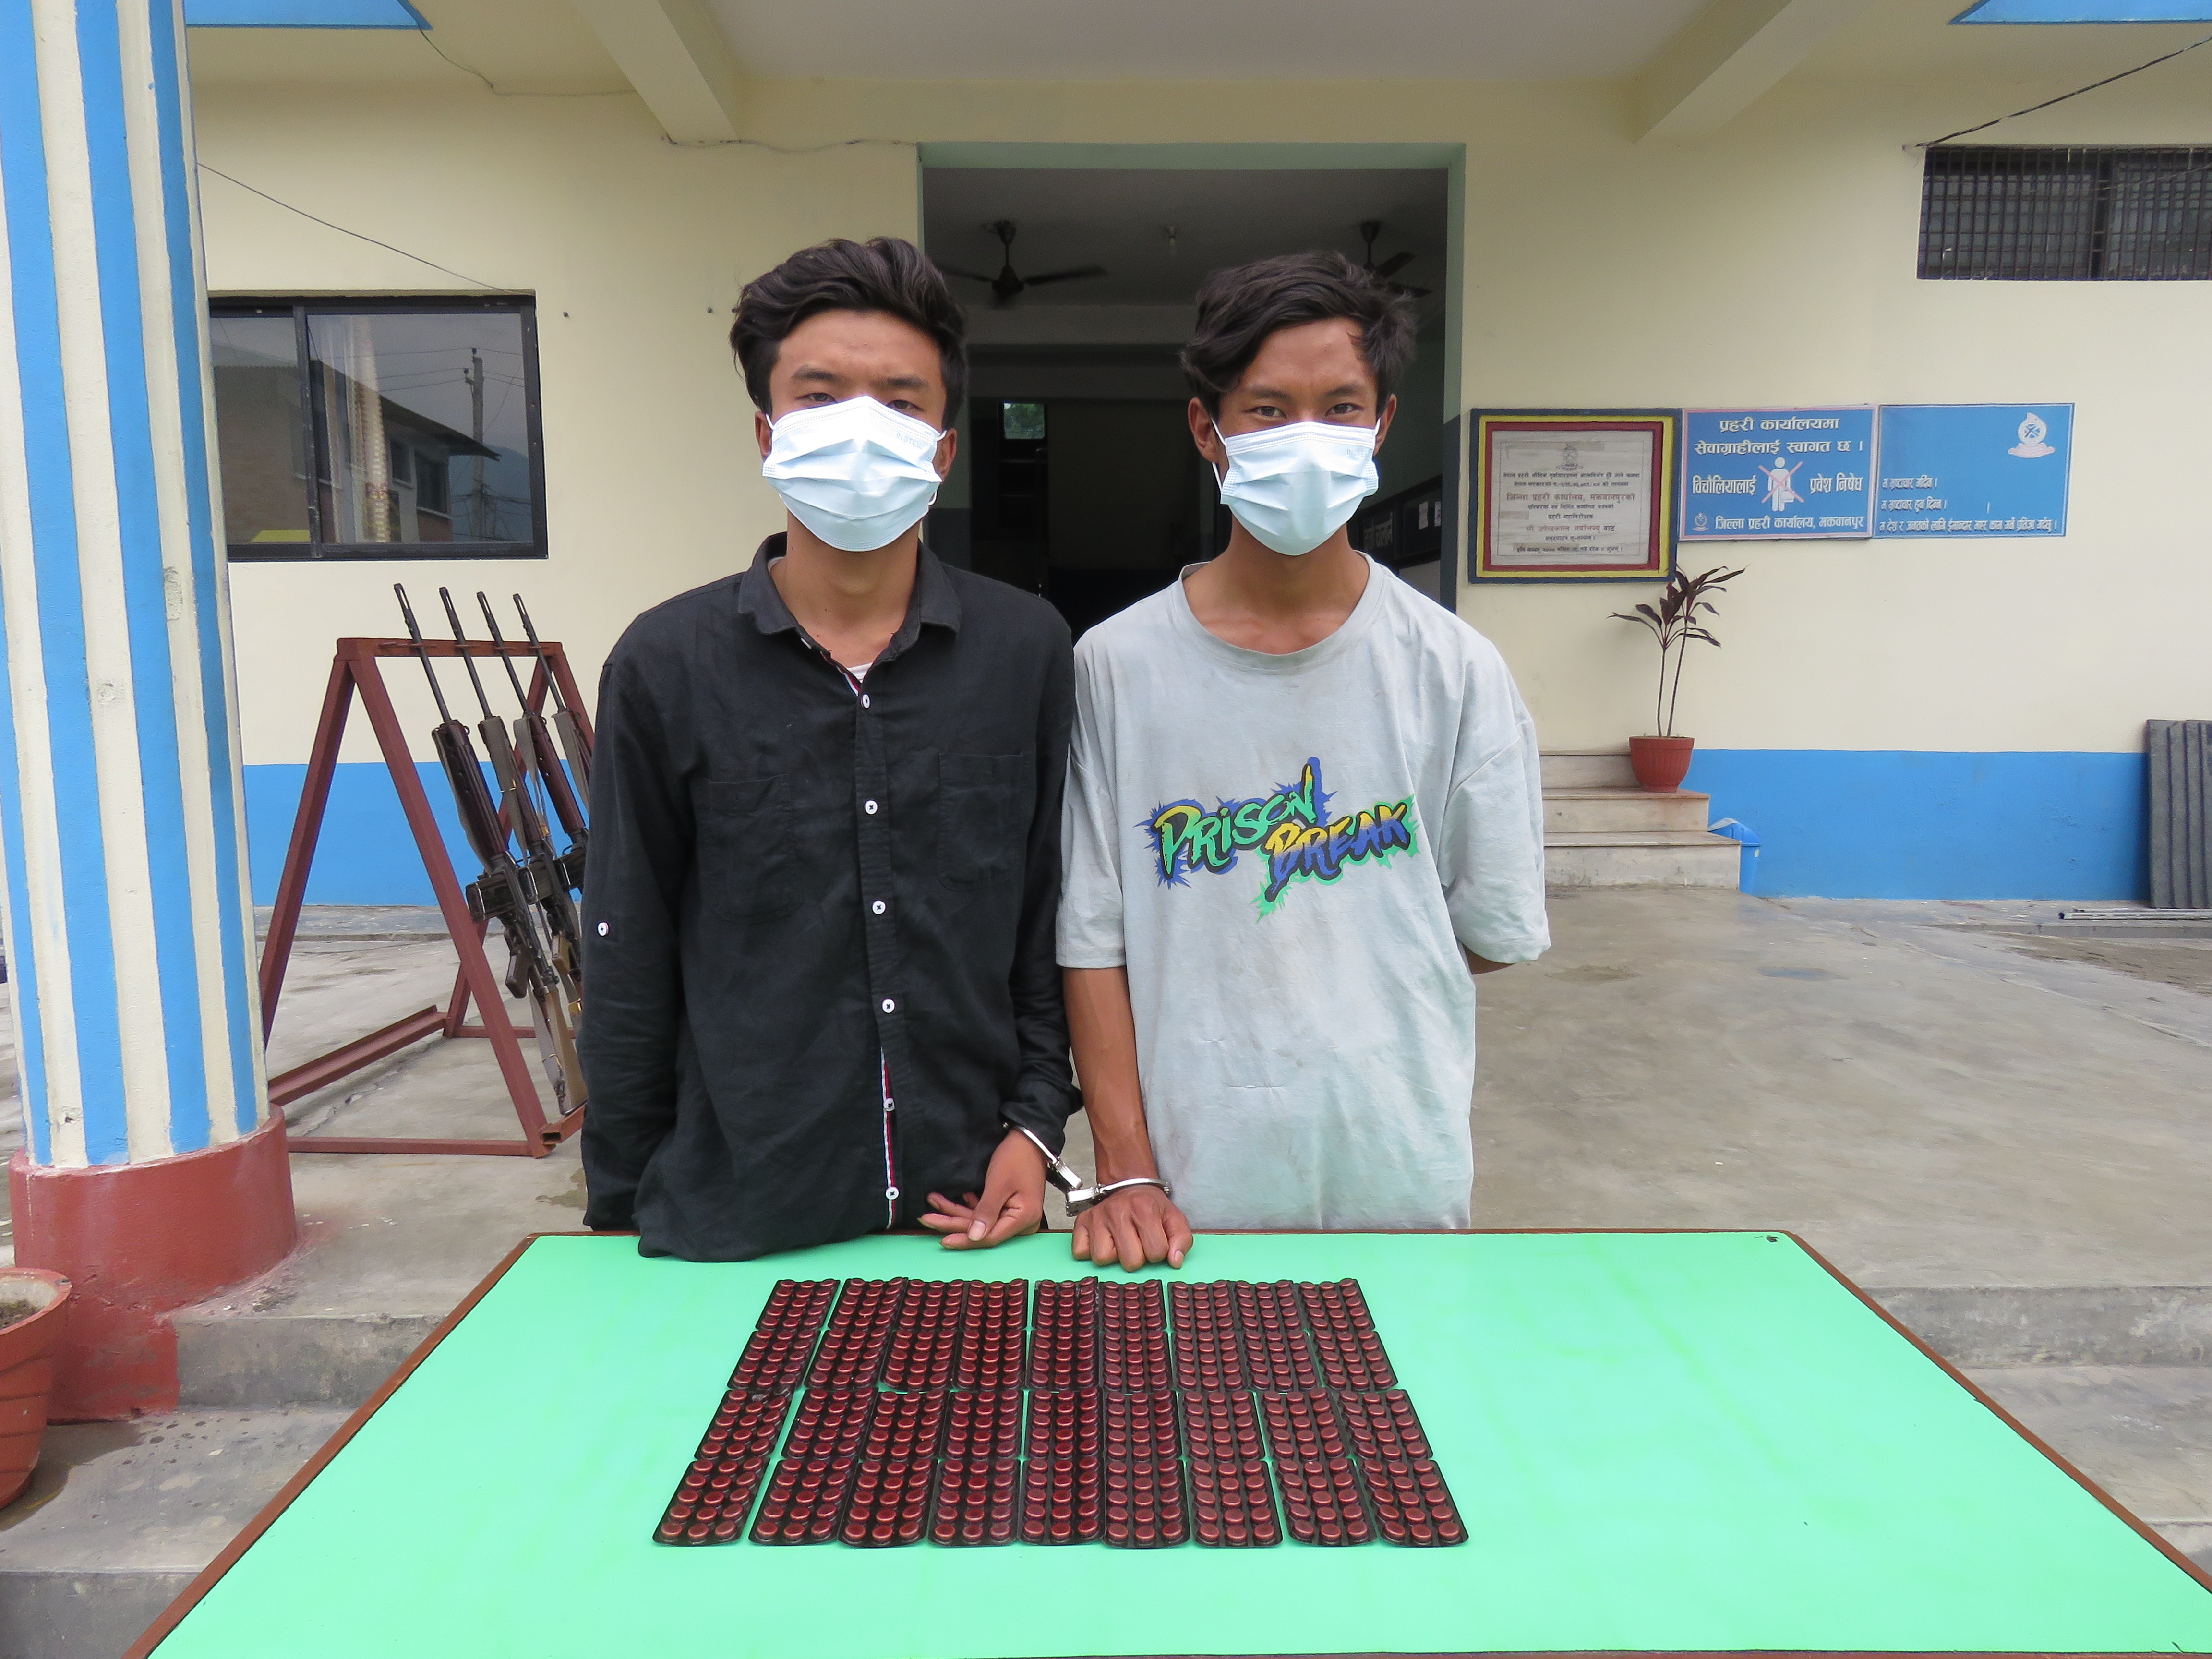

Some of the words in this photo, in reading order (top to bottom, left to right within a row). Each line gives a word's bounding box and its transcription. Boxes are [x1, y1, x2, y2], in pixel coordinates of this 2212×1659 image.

[1719, 417, 1755, 432] प्रहरी
[1760, 416, 1839, 431] कार्यालयमा
[1695, 439, 1780, 455] सेवाग्राहीलाई
[1787, 441, 1831, 453] स्वागत
[1837, 440, 1851, 452] छ
[1810, 473, 1833, 494] प्रवेश
[1836, 472, 1863, 492] निषेध
[1882, 478, 1888, 488] म
[1507, 491, 1528, 500] जिल्ला
[1532, 492, 1550, 501] प्रहरी
[1554, 492, 1585, 501] कार्यालय,
[1590, 492, 1635, 503] मकवानपुरको
[1881, 500, 1887, 510] म
[1715, 515, 1745, 529] जिल्ला
[1748, 515, 1771, 530] प्रहरी
[1774, 515, 1815, 529] कार्यालय,
[1819, 516, 1865, 529] मकवानपुर
[1879, 521, 1886, 531] म
[1887, 518, 1898, 532] देश
[1899, 521, 1905, 531] र
[1931, 517, 1947, 531] लागि
[1152, 761, 1319, 880] PRISON
[1261, 802, 1412, 902] BREAK
